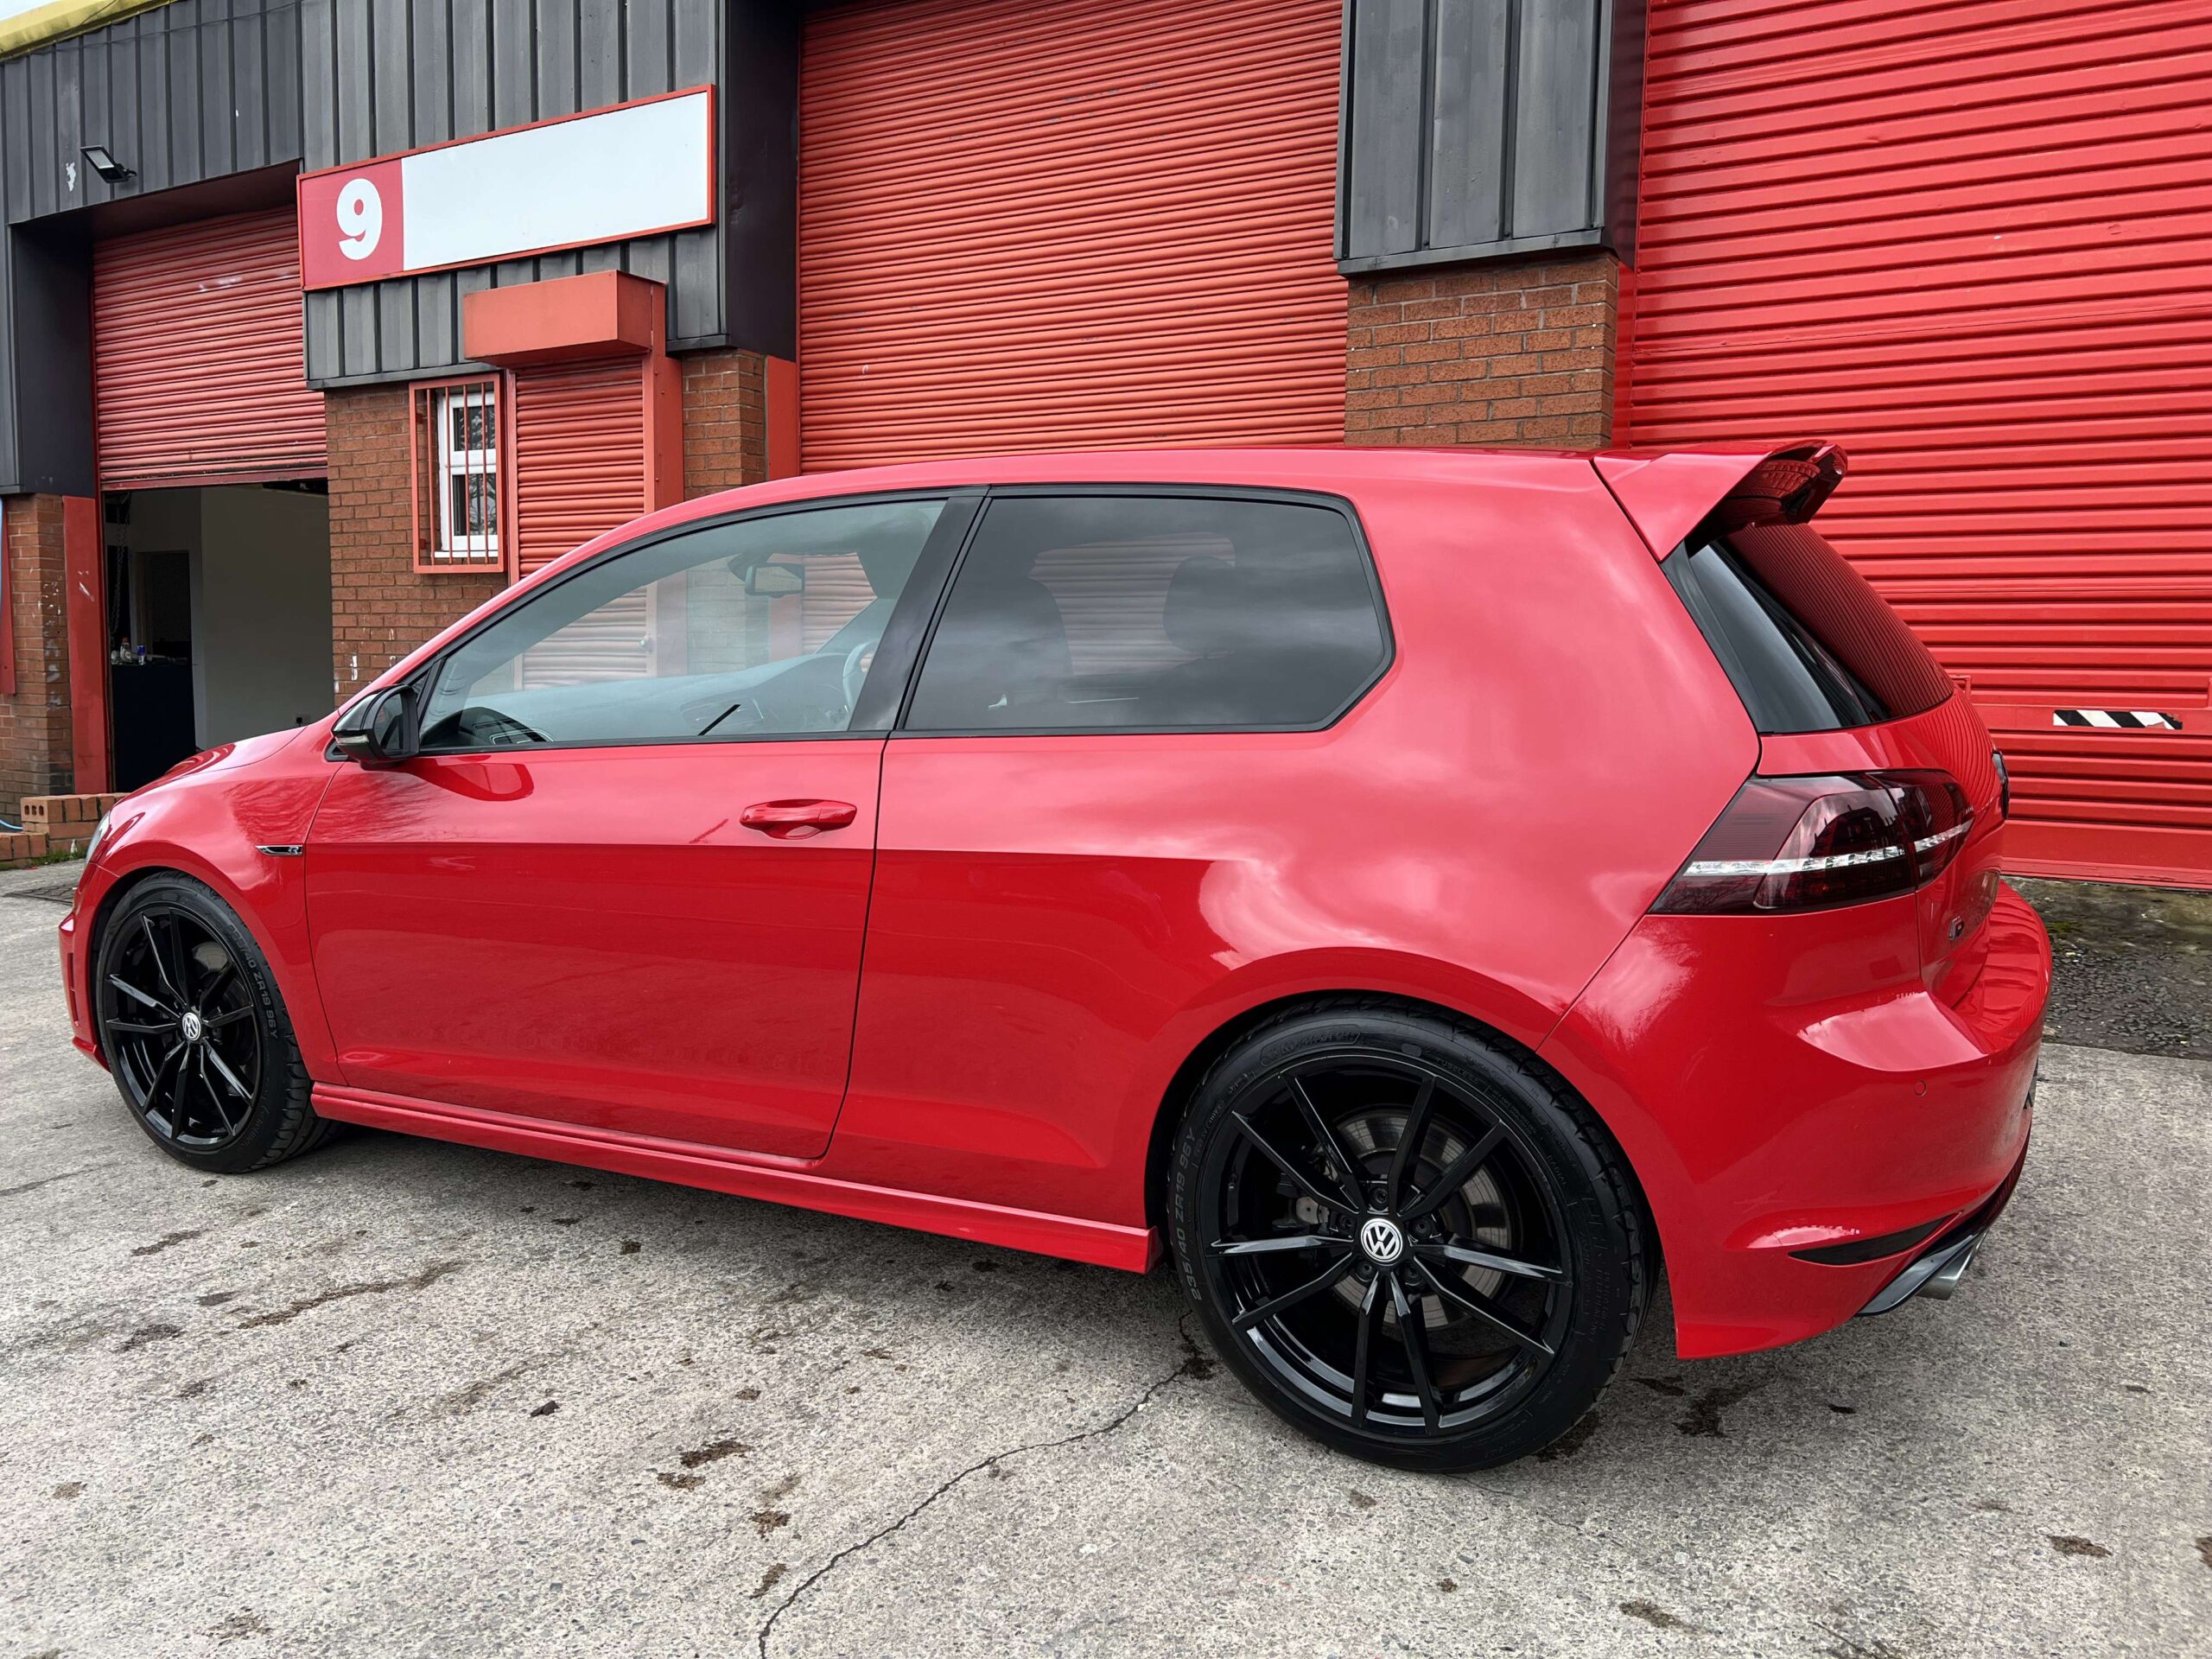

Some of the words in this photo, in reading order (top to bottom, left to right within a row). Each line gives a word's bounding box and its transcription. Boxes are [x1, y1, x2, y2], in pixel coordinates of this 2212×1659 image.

[336, 178, 383, 260] 9
[253, 972, 272, 1007] ZR19
[1175, 1172, 1186, 1221] ZR19
[1176, 1228, 1203, 1300] 235/40
[1363, 1221, 1401, 1260] VW
